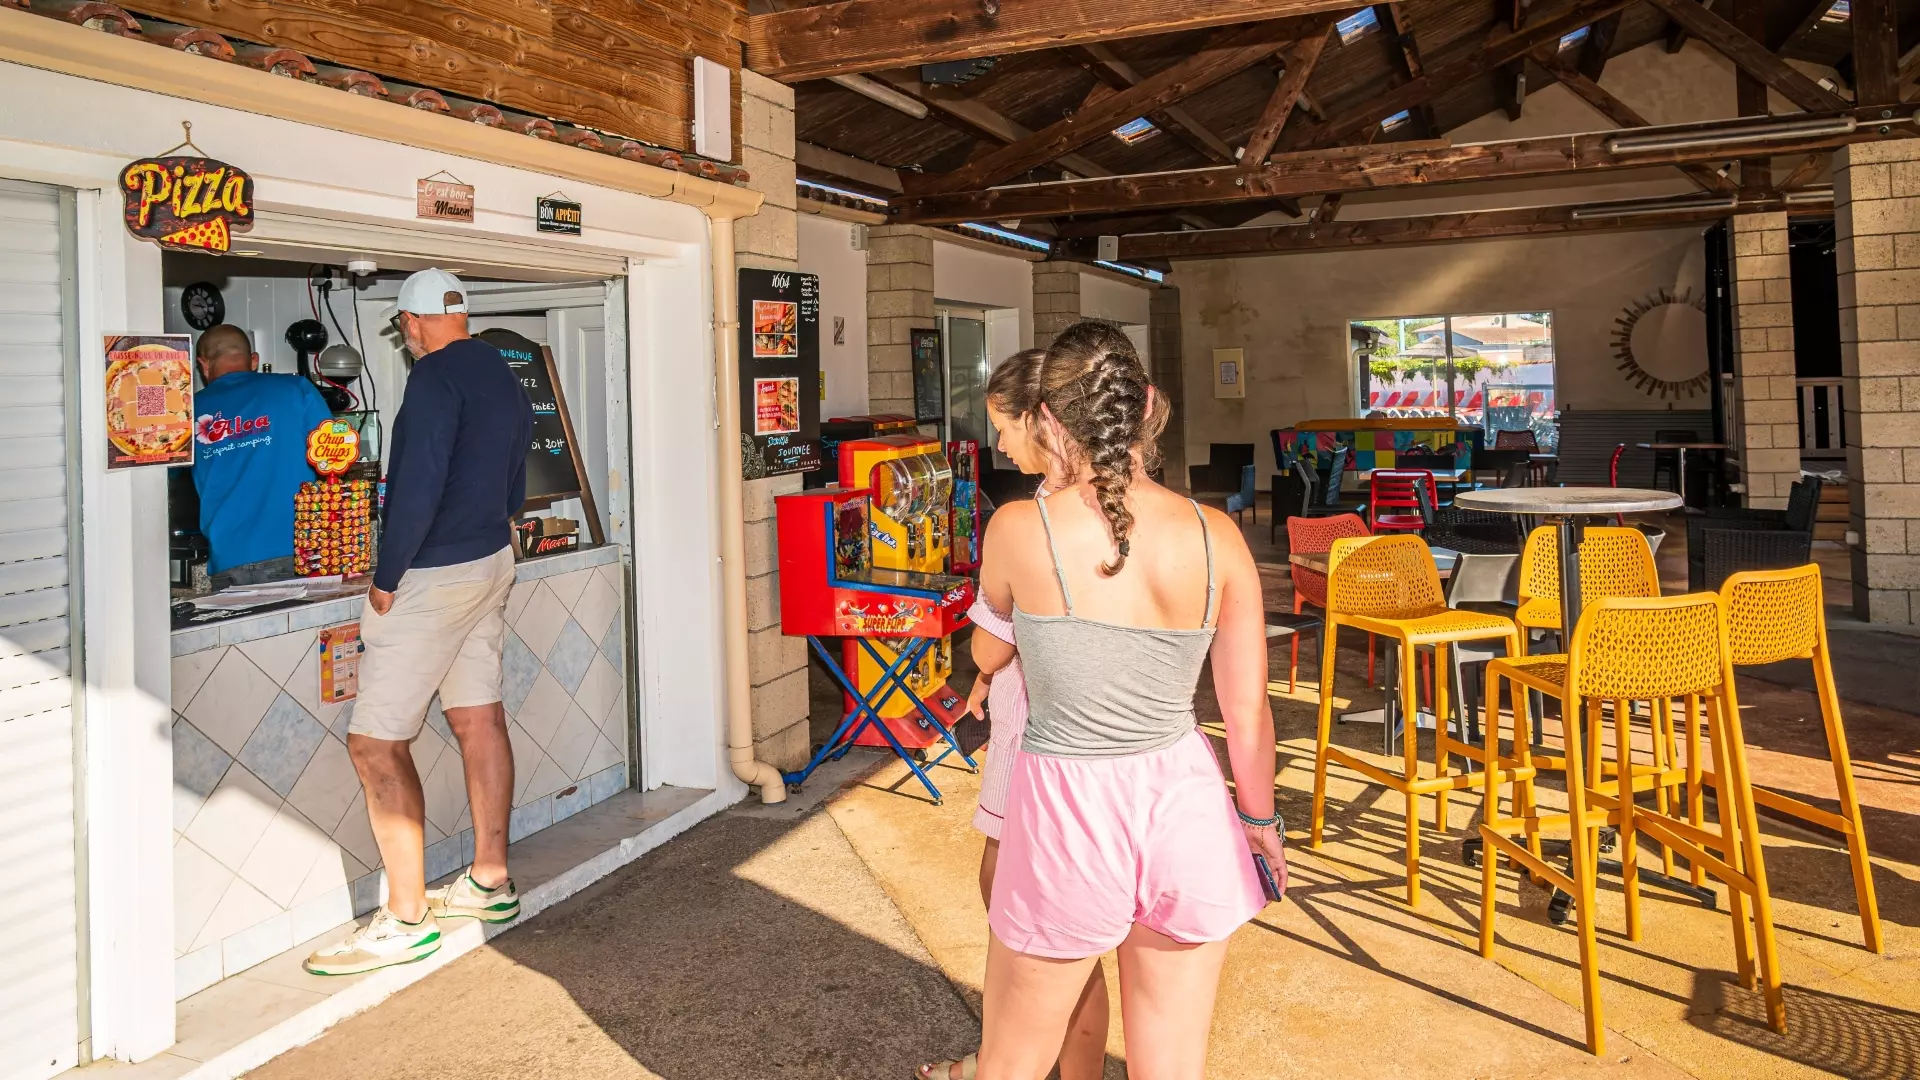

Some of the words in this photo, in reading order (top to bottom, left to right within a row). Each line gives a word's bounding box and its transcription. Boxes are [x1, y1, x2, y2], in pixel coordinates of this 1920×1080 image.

[125, 162, 249, 227] Pizza
[435, 200, 473, 218] Maison!
[540, 206, 554, 220] BON
[154, 351, 163, 359] UN
[166, 351, 181, 359] AVIS
[208, 415, 271, 442] Aloa
[317, 433, 346, 447] Chup
[315, 445, 350, 461] Chups
[536, 536, 568, 553] Mars
[863, 617, 885, 631] SUPER
